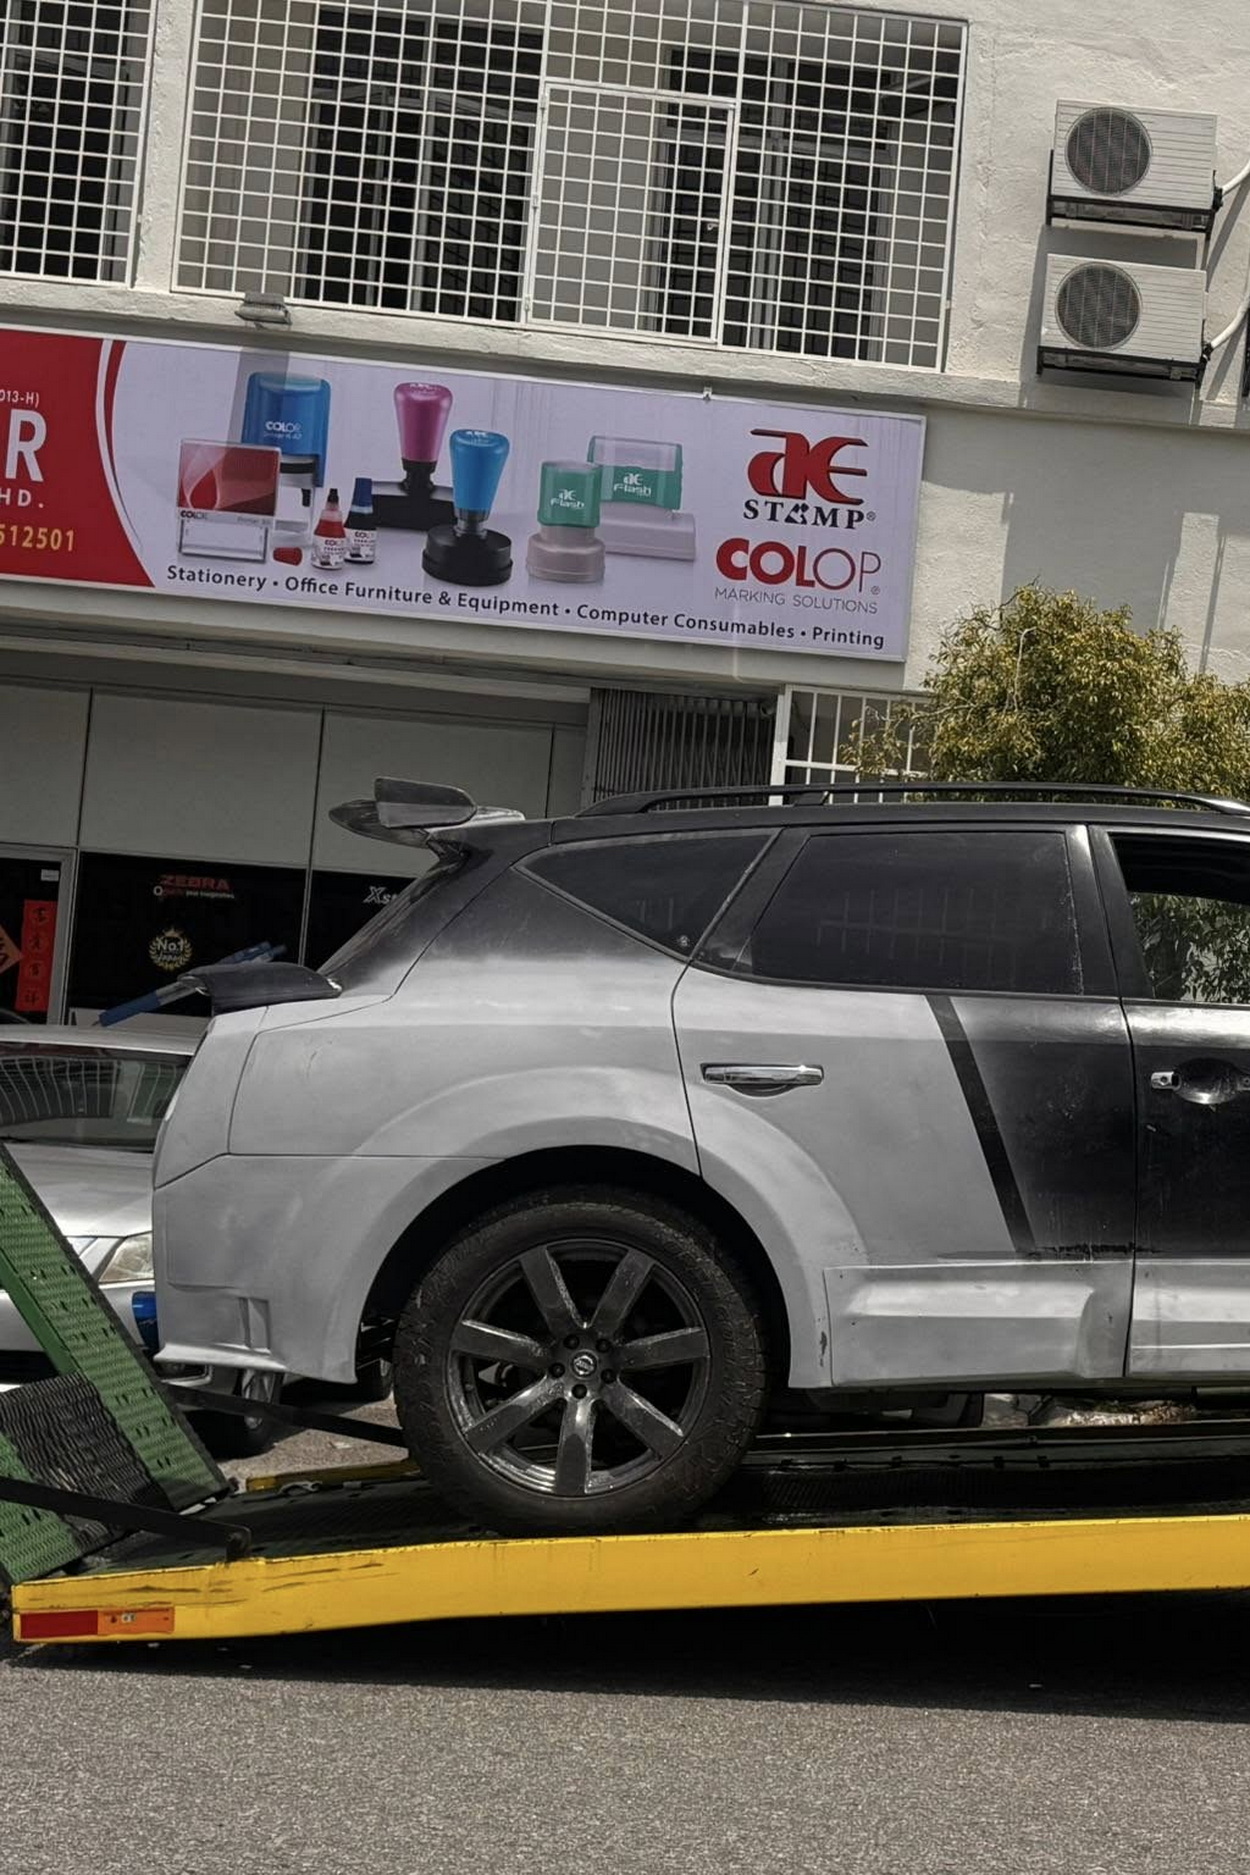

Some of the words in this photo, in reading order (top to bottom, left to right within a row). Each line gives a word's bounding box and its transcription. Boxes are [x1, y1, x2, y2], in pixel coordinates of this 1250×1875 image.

[716, 537, 882, 594] COLOP
[167, 565, 266, 591] Stationery
[285, 576, 338, 595] Office
[345, 582, 433, 604] Furniture
[438, 591, 451, 606] &
[458, 593, 559, 616] Equipment
[577, 604, 669, 626] Computer
[674, 614, 795, 638] Consumables
[812, 627, 884, 650] Printing
[714, 586, 786, 606] MARKING
[793, 594, 878, 615] SOLUTIONS
